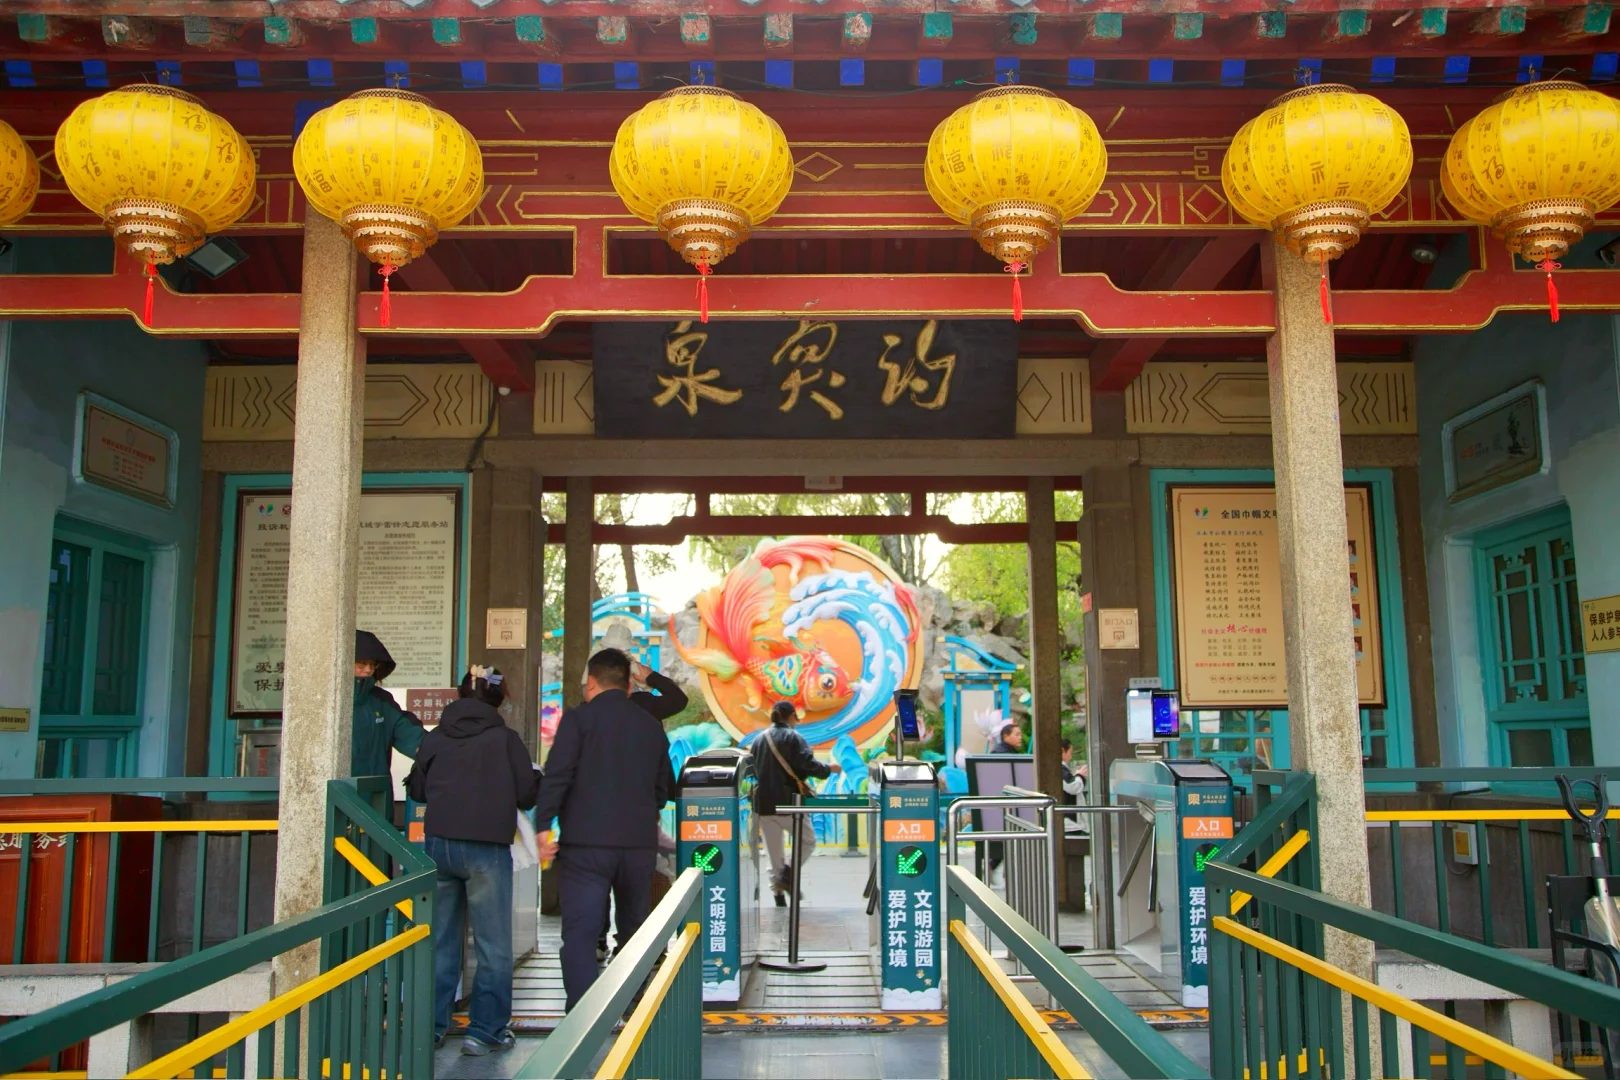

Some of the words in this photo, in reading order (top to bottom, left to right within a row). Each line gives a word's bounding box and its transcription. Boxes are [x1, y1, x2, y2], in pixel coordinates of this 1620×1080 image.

[694, 823, 718, 834] 入口
[897, 822, 921, 834] 入口
[1196, 820, 1219, 831] 入口
[709, 885, 727, 952] 文明游园
[888, 889, 908, 967] 爱护环境
[914, 889, 934, 967] 文明游园
[1189, 887, 1208, 965] 爱护环境
